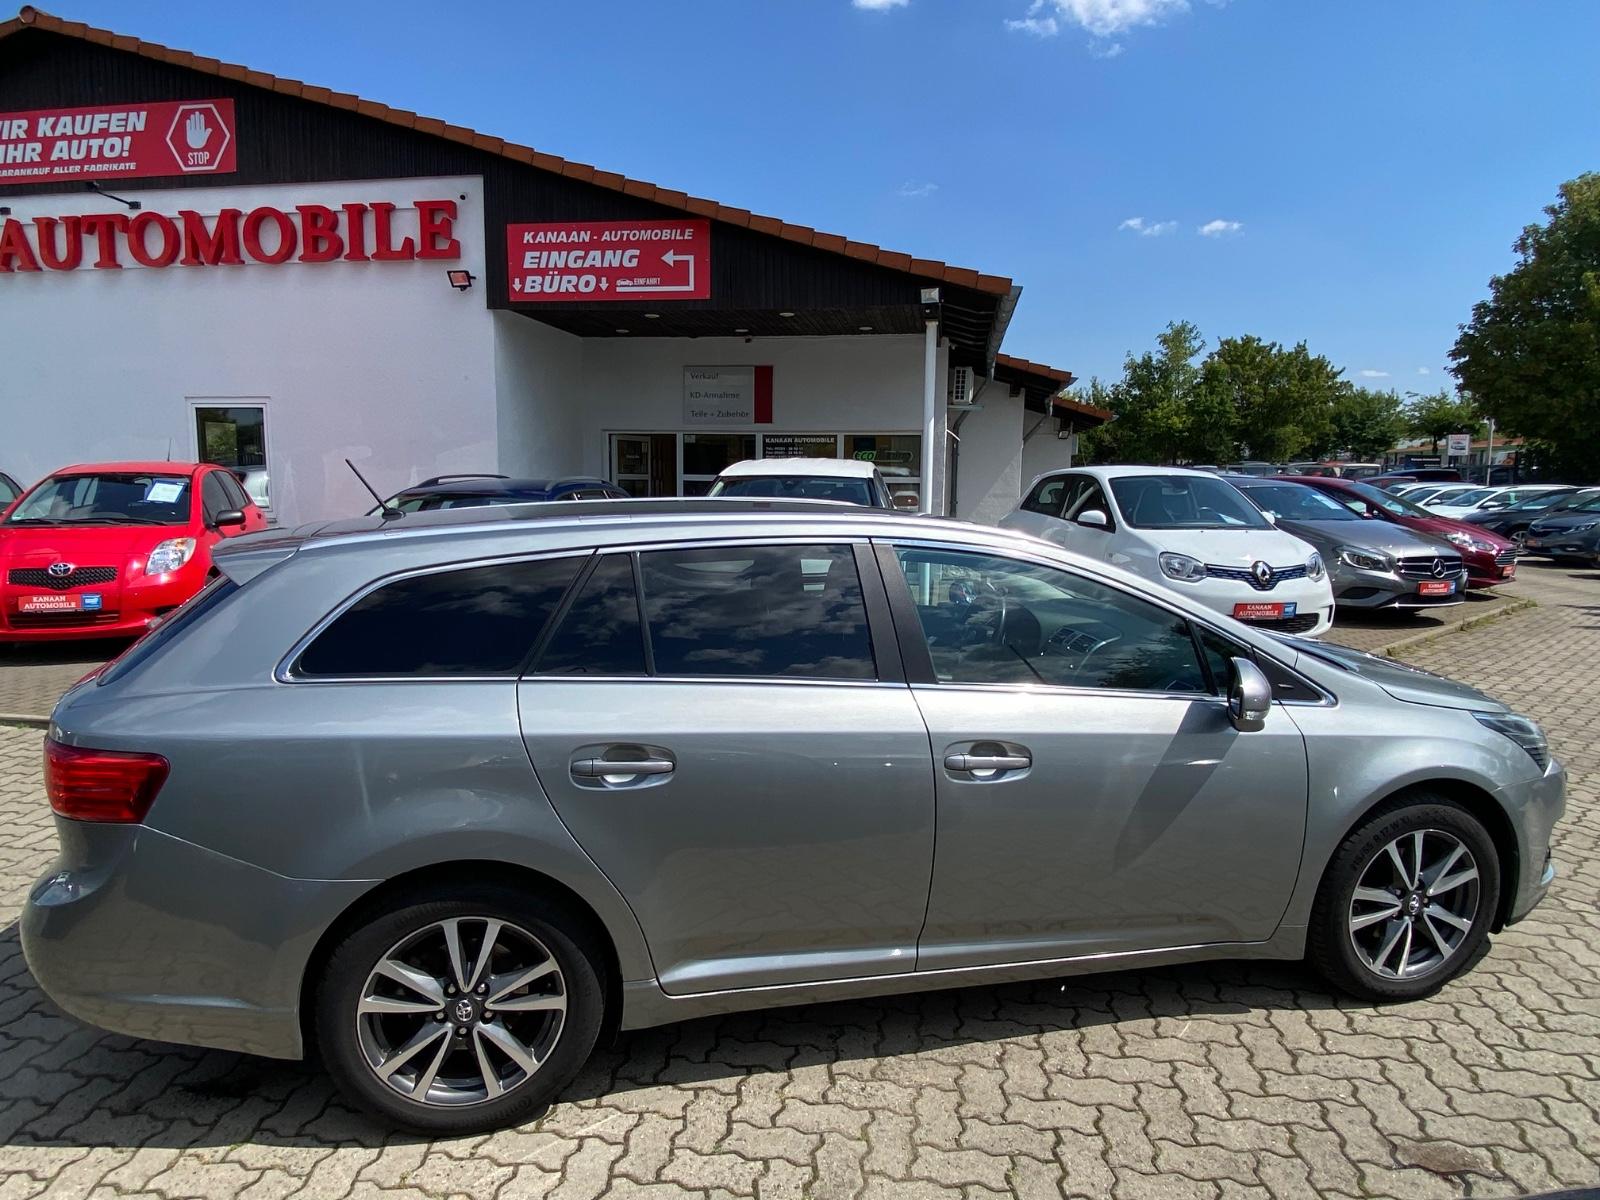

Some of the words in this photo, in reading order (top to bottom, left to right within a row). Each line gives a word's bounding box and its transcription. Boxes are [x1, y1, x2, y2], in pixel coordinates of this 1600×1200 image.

[0, 119, 29, 140] IR
[37, 111, 147, 138] KAUFEN
[0, 142, 42, 164] IHR
[50, 136, 132, 161] AUTO!
[187, 151, 210, 165] STOP
[0, 167, 51, 177] ARANKAUF
[53, 165, 81, 174] ALLER
[83, 162, 136, 172] FABRIKATE
[0, 200, 462, 273] AUTOMOBILE
[523, 230, 591, 244] KANAAN
[601, 228, 694, 242] AUTOMOBILE
[523, 249, 640, 269] EINGANG
[524, 271, 597, 293] BÜRO
[634, 277, 661, 286] EINFAHRT
[690, 372, 719, 380] Verkauf
[690, 410, 709, 418] Teile
[716, 410, 750, 418] Zubehör
[24, 602, 76, 610] AUTOMOBILE
[32, 595, 66, 603] KANAAN
